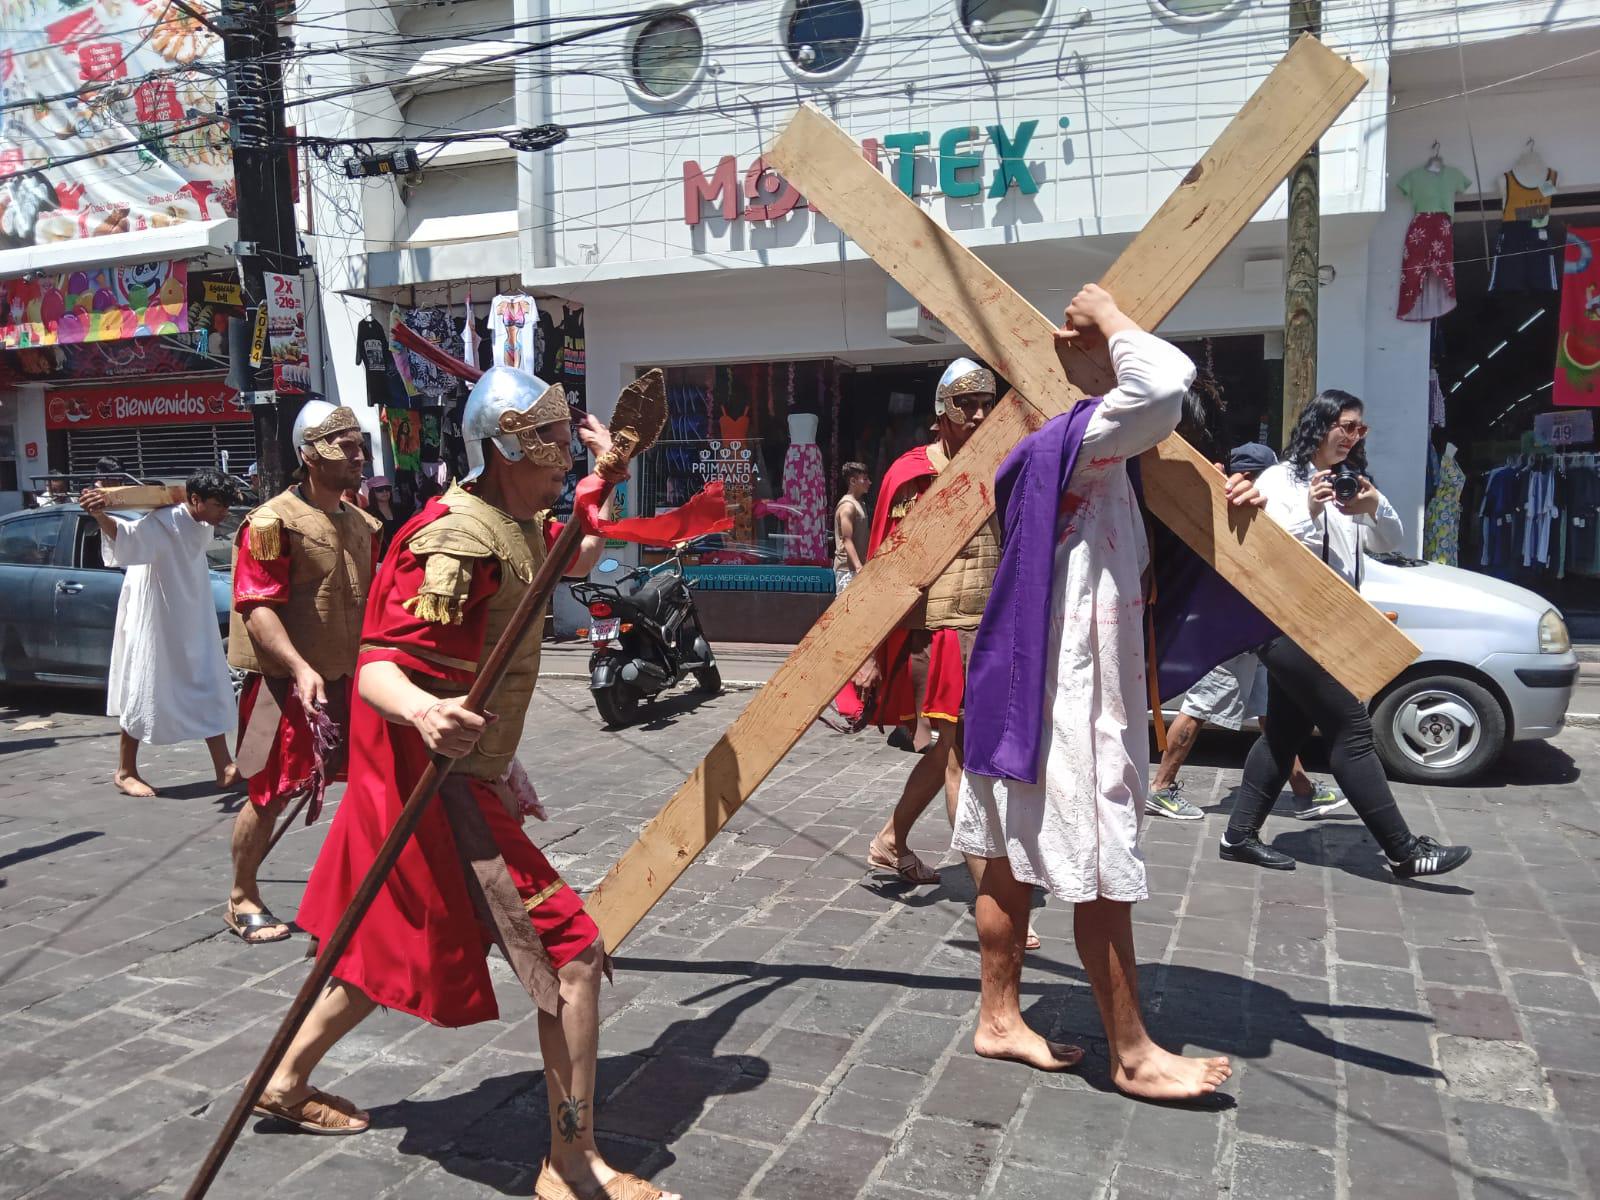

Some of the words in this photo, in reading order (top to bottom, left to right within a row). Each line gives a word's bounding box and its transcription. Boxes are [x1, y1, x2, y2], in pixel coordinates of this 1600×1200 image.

[683, 119, 1040, 225] MOTEX
[114, 390, 206, 419] Bienvenidos
[692, 462, 759, 474] PRIMAVERA
[702, 473, 750, 483] VERANO
[760, 575, 821, 583] DECORACIONES
